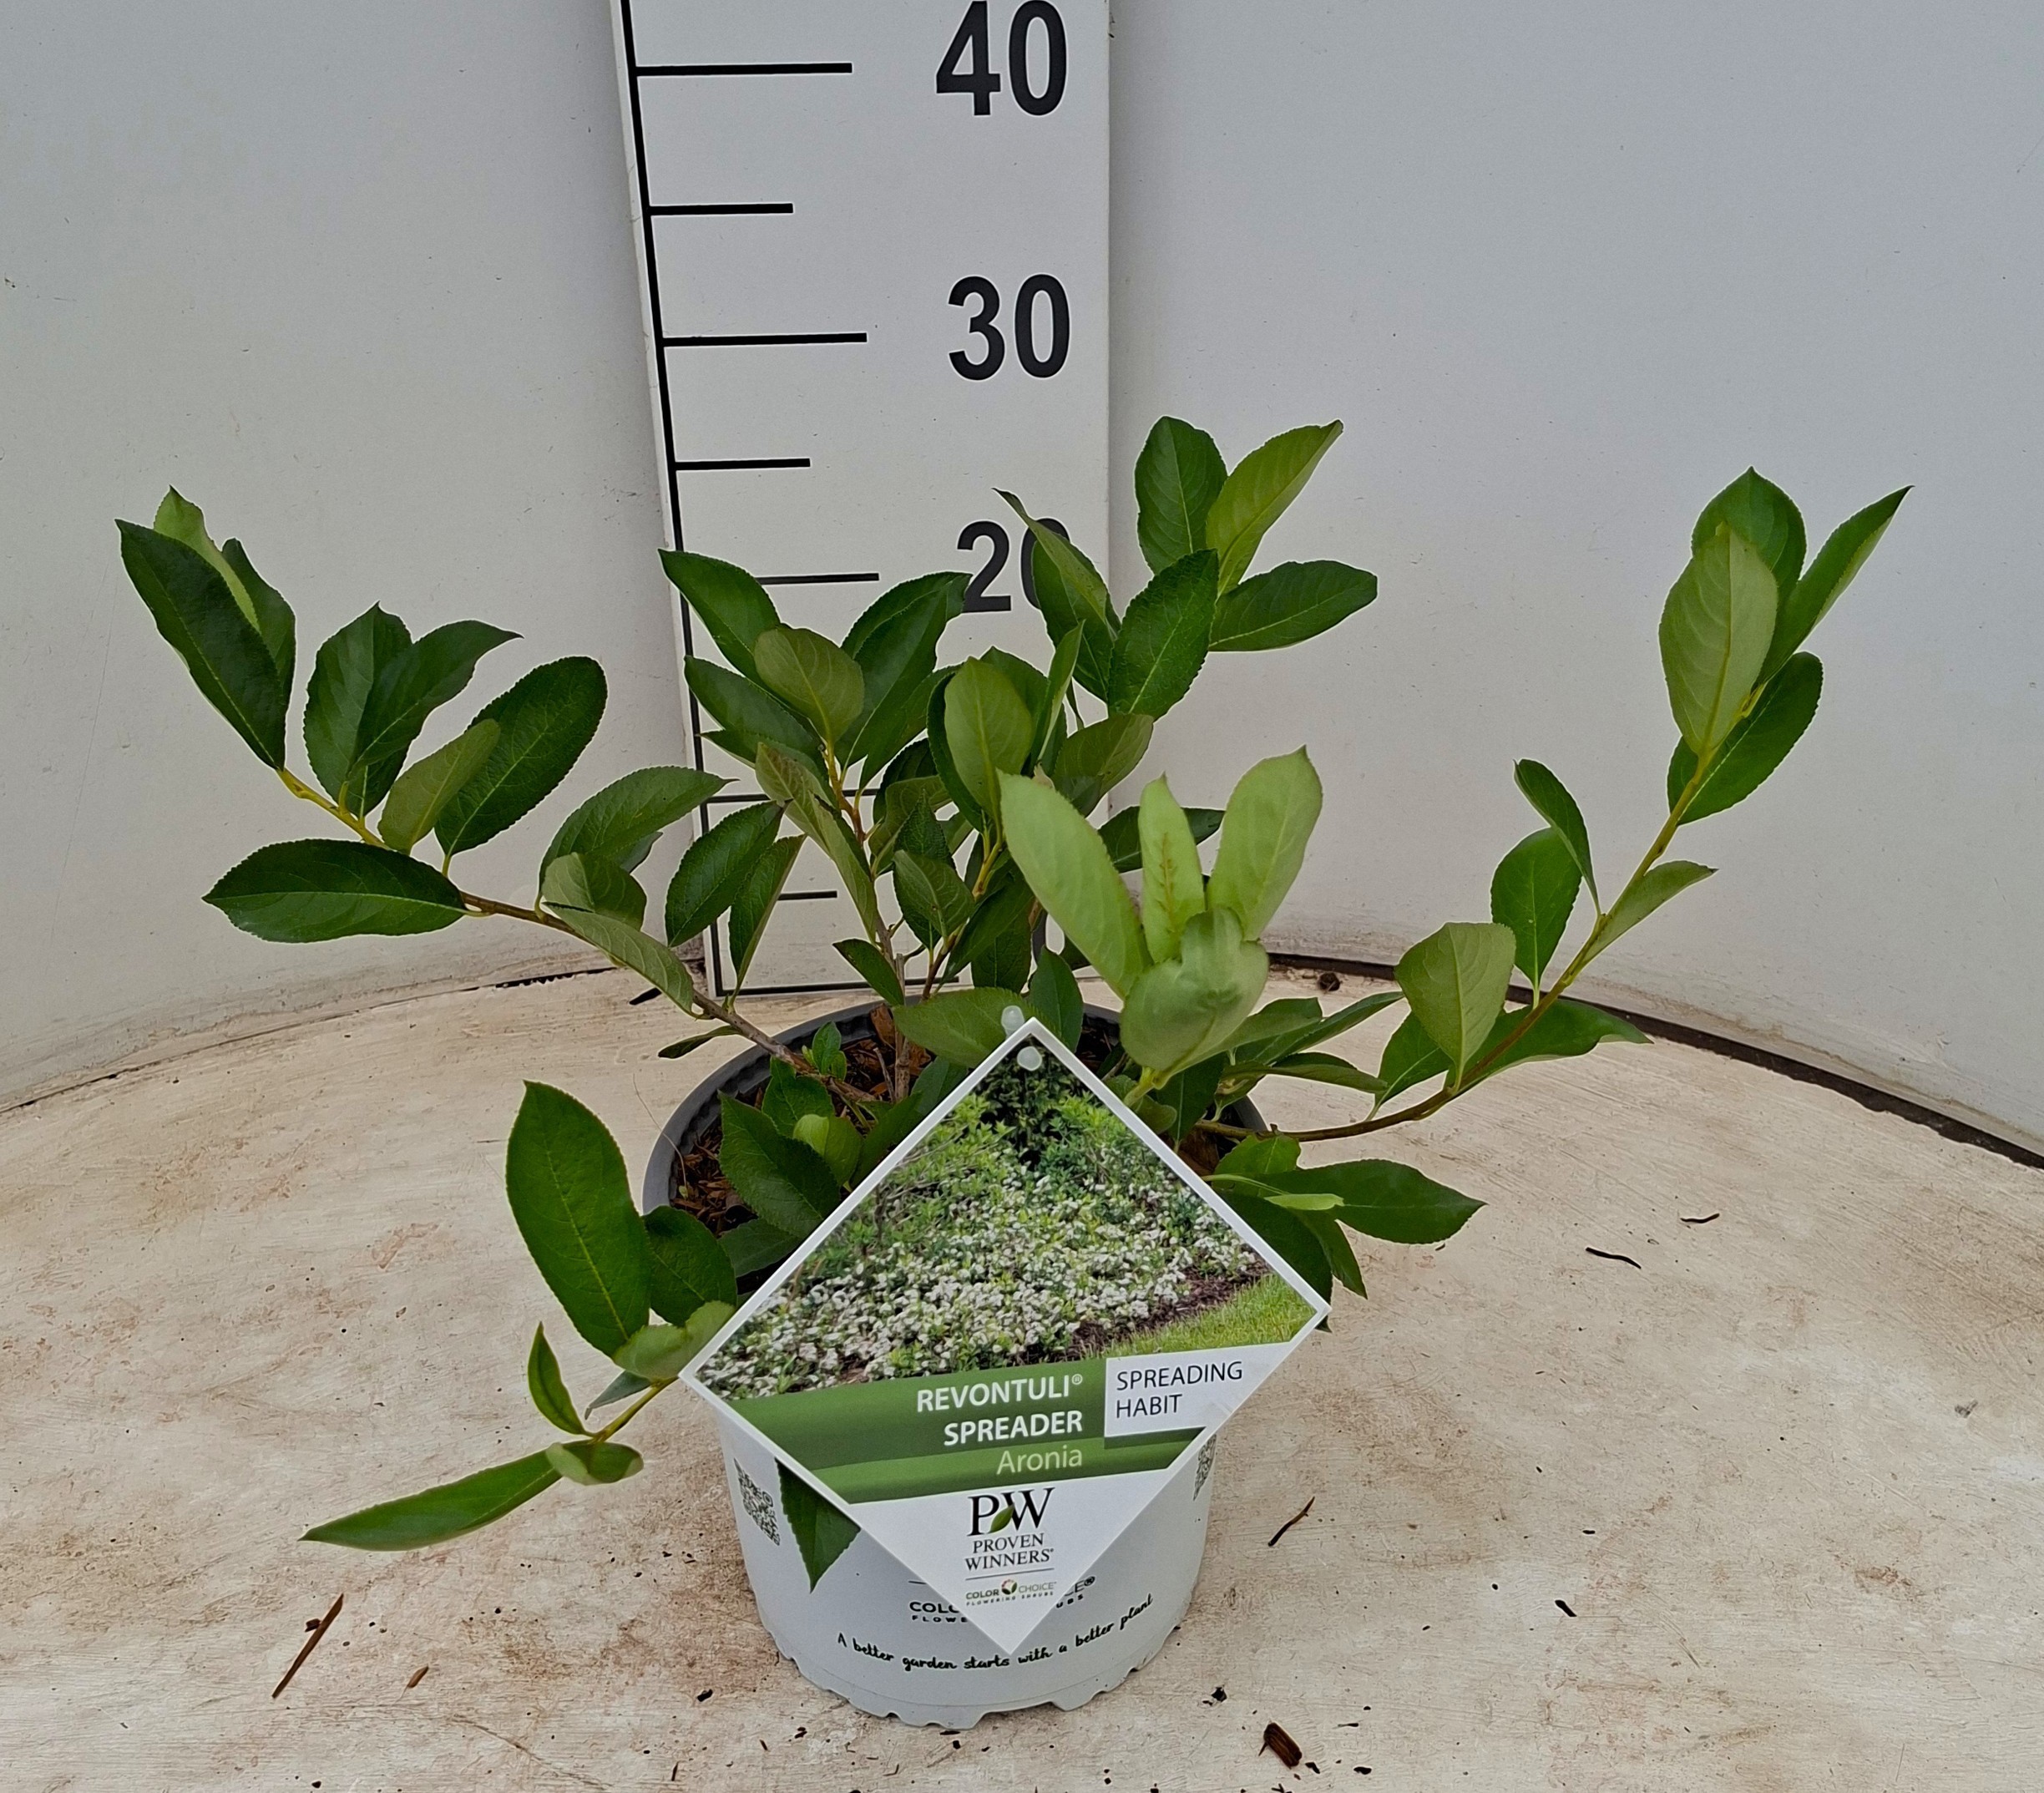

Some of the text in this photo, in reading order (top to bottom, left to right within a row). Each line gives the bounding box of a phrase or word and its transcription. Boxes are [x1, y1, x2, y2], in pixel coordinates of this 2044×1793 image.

[936, 0, 1066, 115] 40
[949, 274, 1070, 380] 30
[1116, 1360, 1243, 1391] SPREADING
[1116, 1394, 1183, 1419] HABIT
[944, 1411, 1083, 1446] SPREADER
[996, 1445, 1083, 1476] Aronia
[967, 1487, 1055, 1537] PW
[973, 1532, 1045, 1553] PROVEN
[965, 1588, 999, 1600] COLOR
[837, 1593, 1153, 1671] A better garden starts with a better plant
